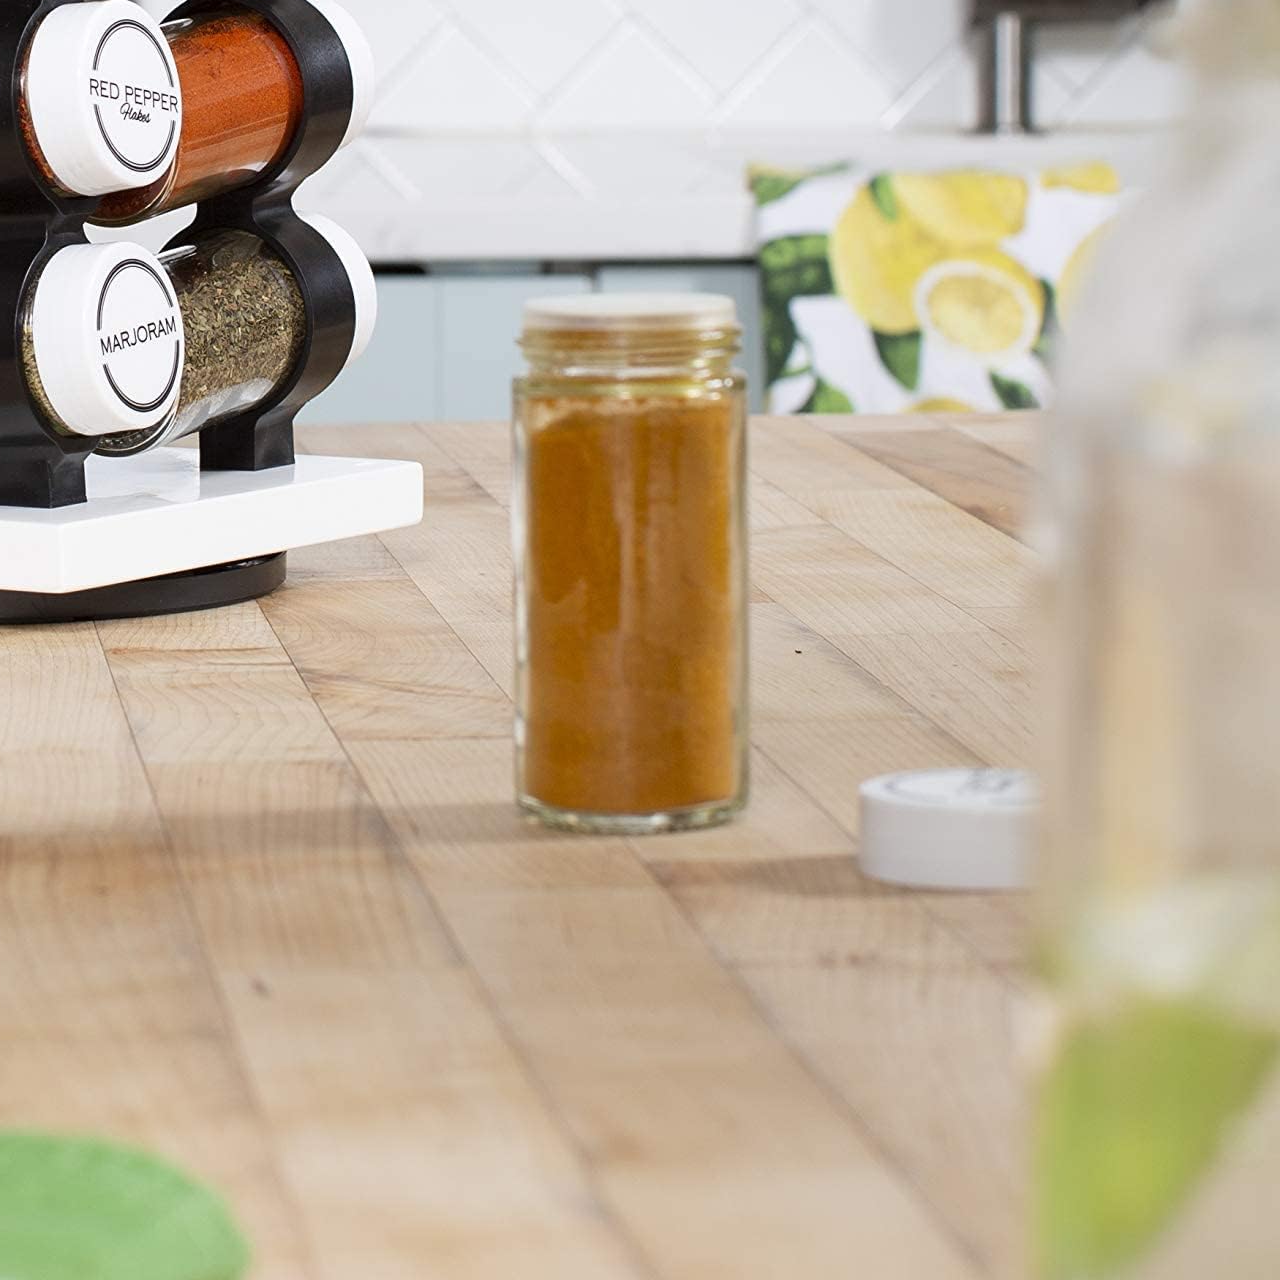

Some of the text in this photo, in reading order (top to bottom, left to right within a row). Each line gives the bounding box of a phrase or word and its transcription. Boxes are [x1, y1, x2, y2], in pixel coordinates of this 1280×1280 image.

[89, 78, 179, 113] RED PEPPER
[119, 102, 152, 124] Flakes
[100, 315, 177, 356] MARJORAM
